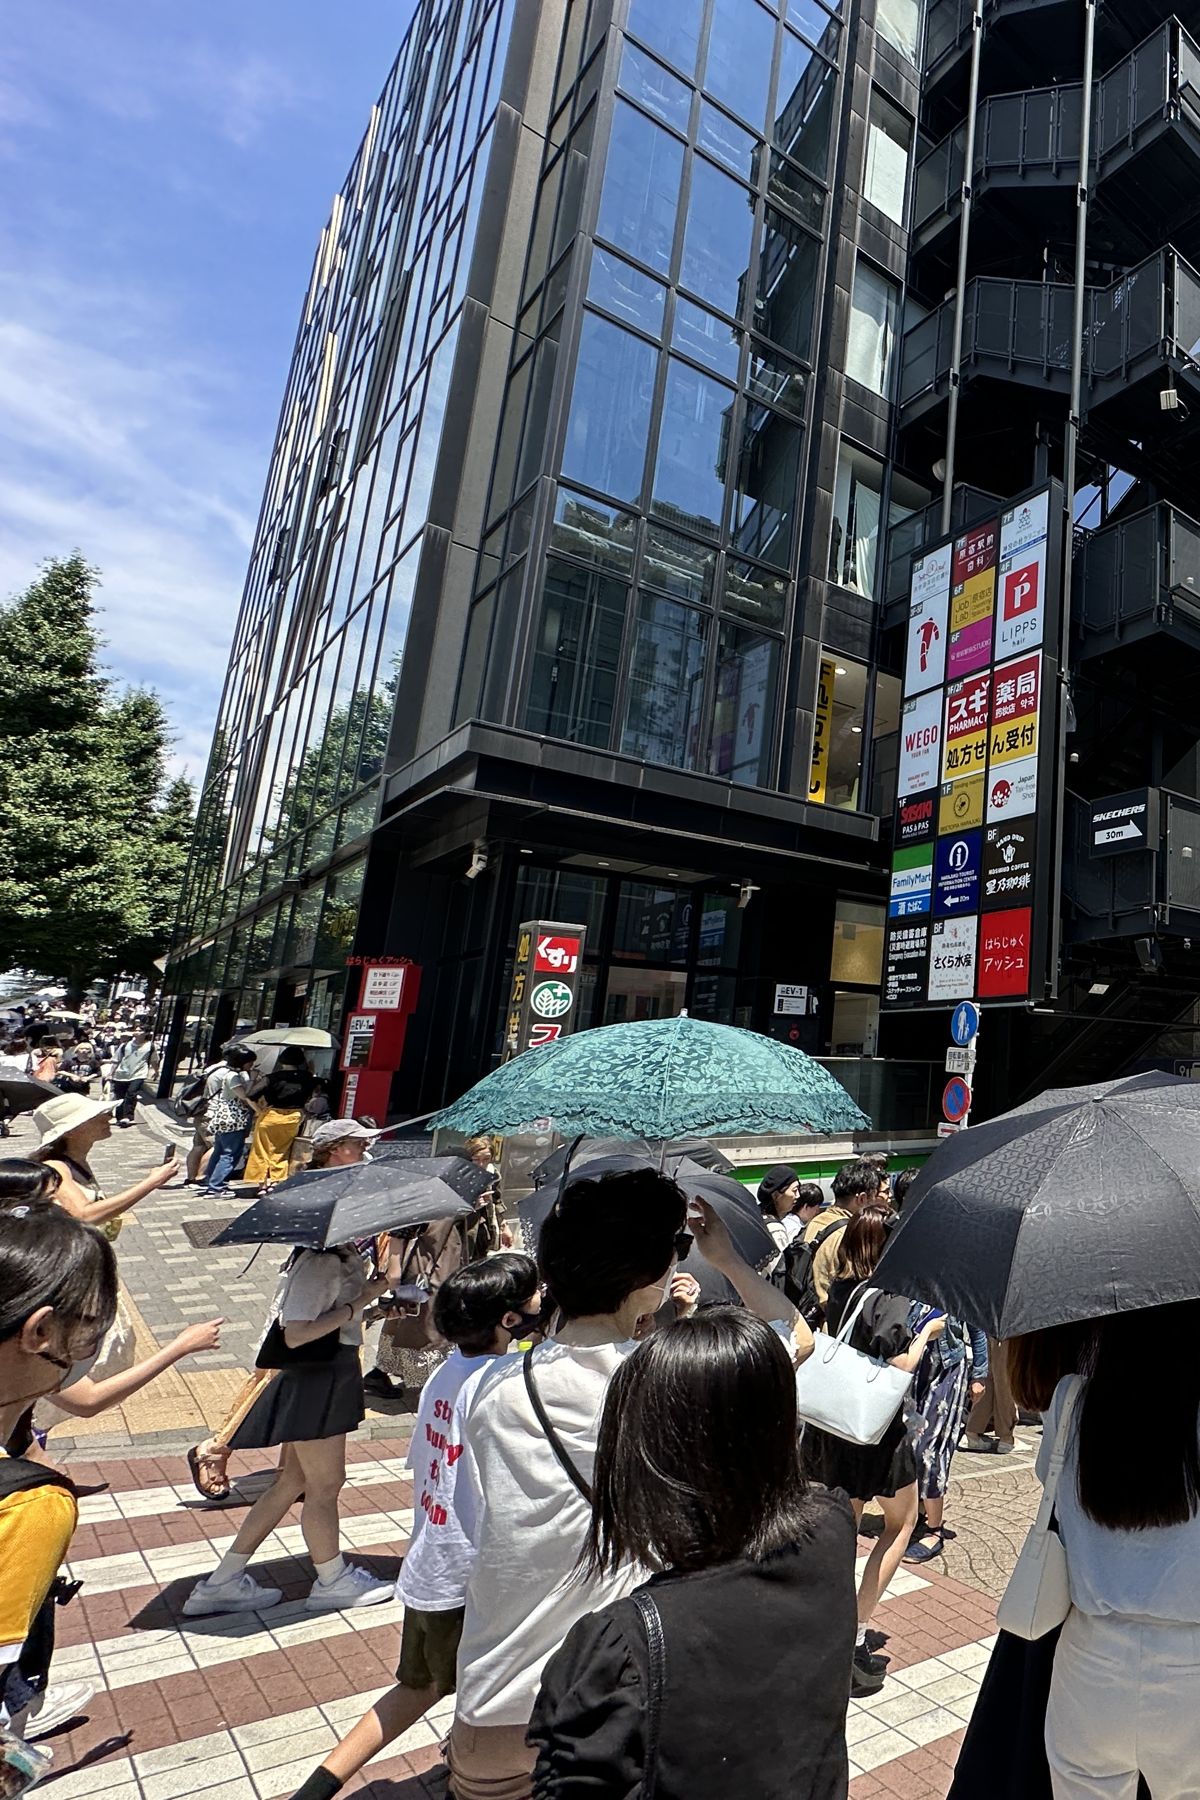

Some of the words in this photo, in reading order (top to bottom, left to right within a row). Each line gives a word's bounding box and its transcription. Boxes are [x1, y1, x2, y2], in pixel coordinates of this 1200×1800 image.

[1001, 562, 1011, 573] 4F
[954, 584, 964, 595] 6F
[1002, 618, 1037, 642] LIPPS
[952, 633, 960, 643] 6F
[1012, 638, 1025, 648] hair
[949, 712, 989, 735] PHARMACY
[905, 725, 938, 753] WEGO
[946, 722, 1035, 770] 処方せん受付
[1018, 774, 1035, 784] Japan
[942, 784, 952, 795] 1F
[1022, 792, 1035, 800] Shop
[899, 798, 907, 808] 1F
[1092, 804, 1146, 823] SKECHERS
[902, 824, 912, 834] PAS
[918, 821, 929, 830] PAS
[987, 829, 997, 841] BF
[1105, 829, 1124, 841] 30m
[1011, 862, 1030, 871] COFFEE
[892, 873, 932, 889] FamilyMart
[986, 872, 1031, 896] 星乃珈琲
[934, 923, 943, 934] BF
[985, 934, 1024, 951] はらじゅく
[537, 937, 578, 973] くすり
[934, 954, 972, 970] さくら水産
[984, 956, 1024, 973] アッシュ
